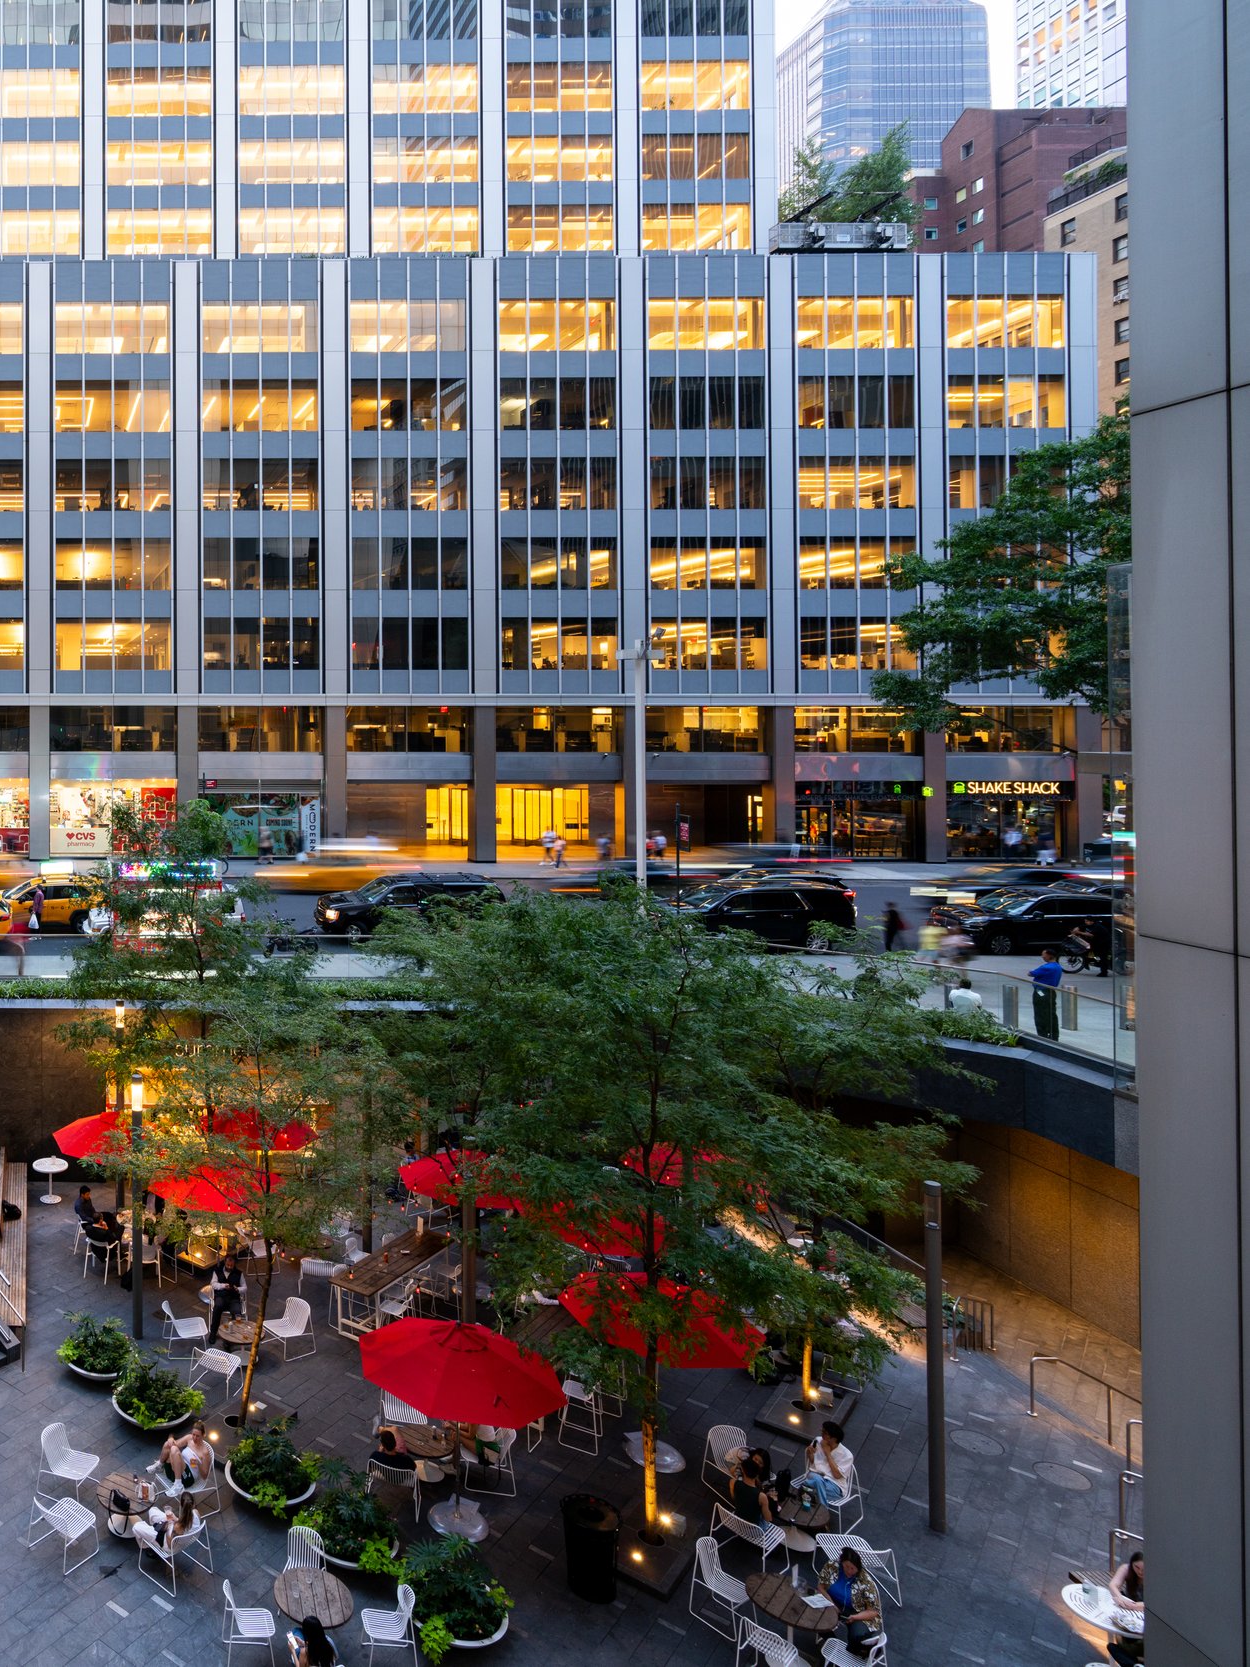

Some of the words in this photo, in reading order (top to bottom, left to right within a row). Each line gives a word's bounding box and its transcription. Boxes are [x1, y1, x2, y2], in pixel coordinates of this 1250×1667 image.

[967, 781, 1012, 794] SHAKE
[1013, 781, 1060, 794] SHACK
[75, 832, 96, 840] CVS
